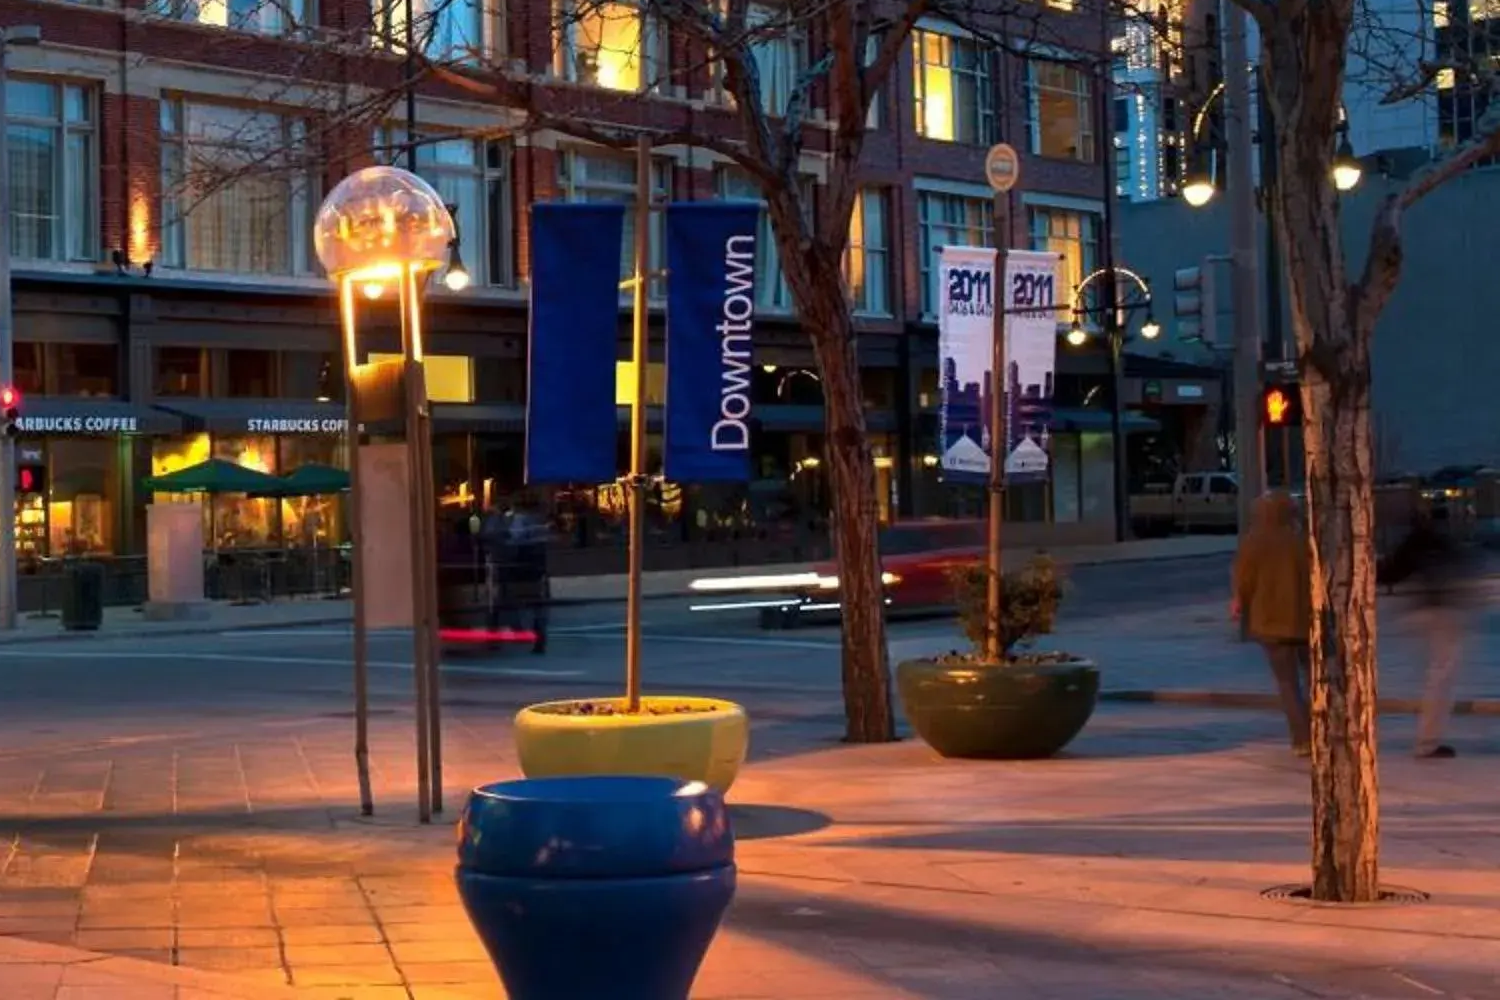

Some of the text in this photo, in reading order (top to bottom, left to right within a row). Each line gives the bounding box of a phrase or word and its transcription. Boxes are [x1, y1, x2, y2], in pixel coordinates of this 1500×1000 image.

[949, 268, 991, 303] 2011
[1013, 273, 1053, 308] 2011
[711, 234, 755, 450] Downtown
[15, 416, 137, 431] ARBUCKS COFFEE
[247, 419, 319, 432] STARBUCKS
